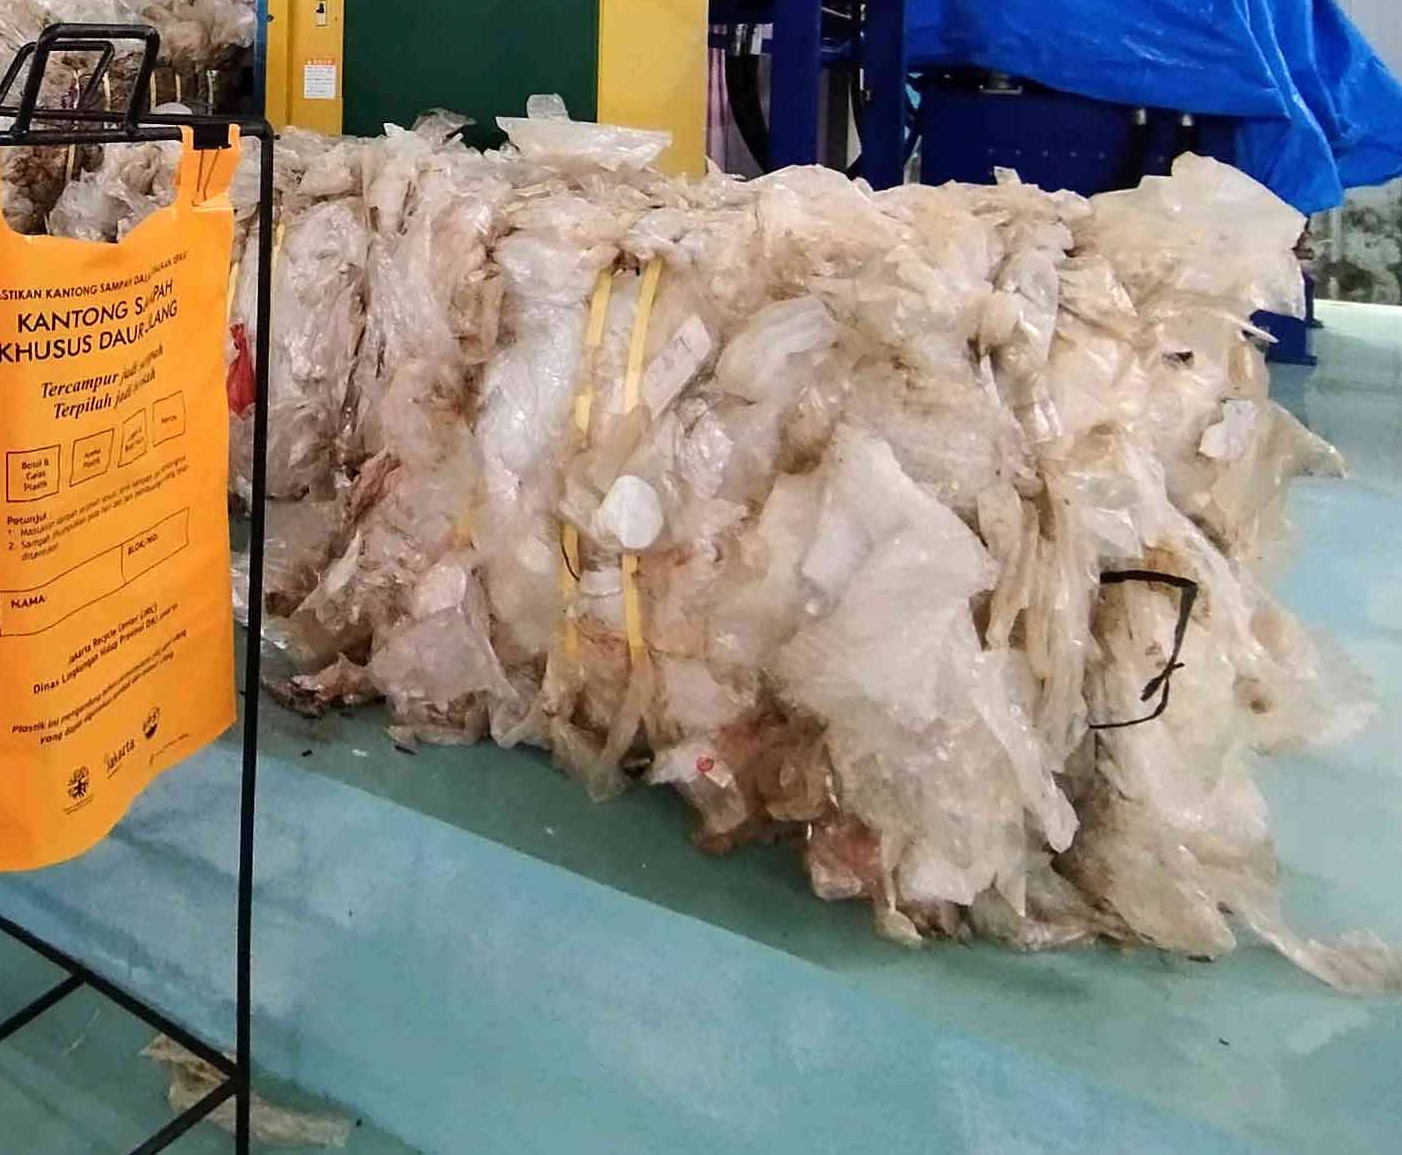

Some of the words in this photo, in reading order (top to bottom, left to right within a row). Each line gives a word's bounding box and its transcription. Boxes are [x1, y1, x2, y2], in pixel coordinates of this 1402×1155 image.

[45, 286, 98, 301] KANTONG
[17, 301, 128, 334] KANTONG
[99, 321, 144, 351] DAUR
[145, 299, 178, 334] LANG
[41, 371, 120, 398] Tercampur
[53, 392, 112, 420] Terpilah
